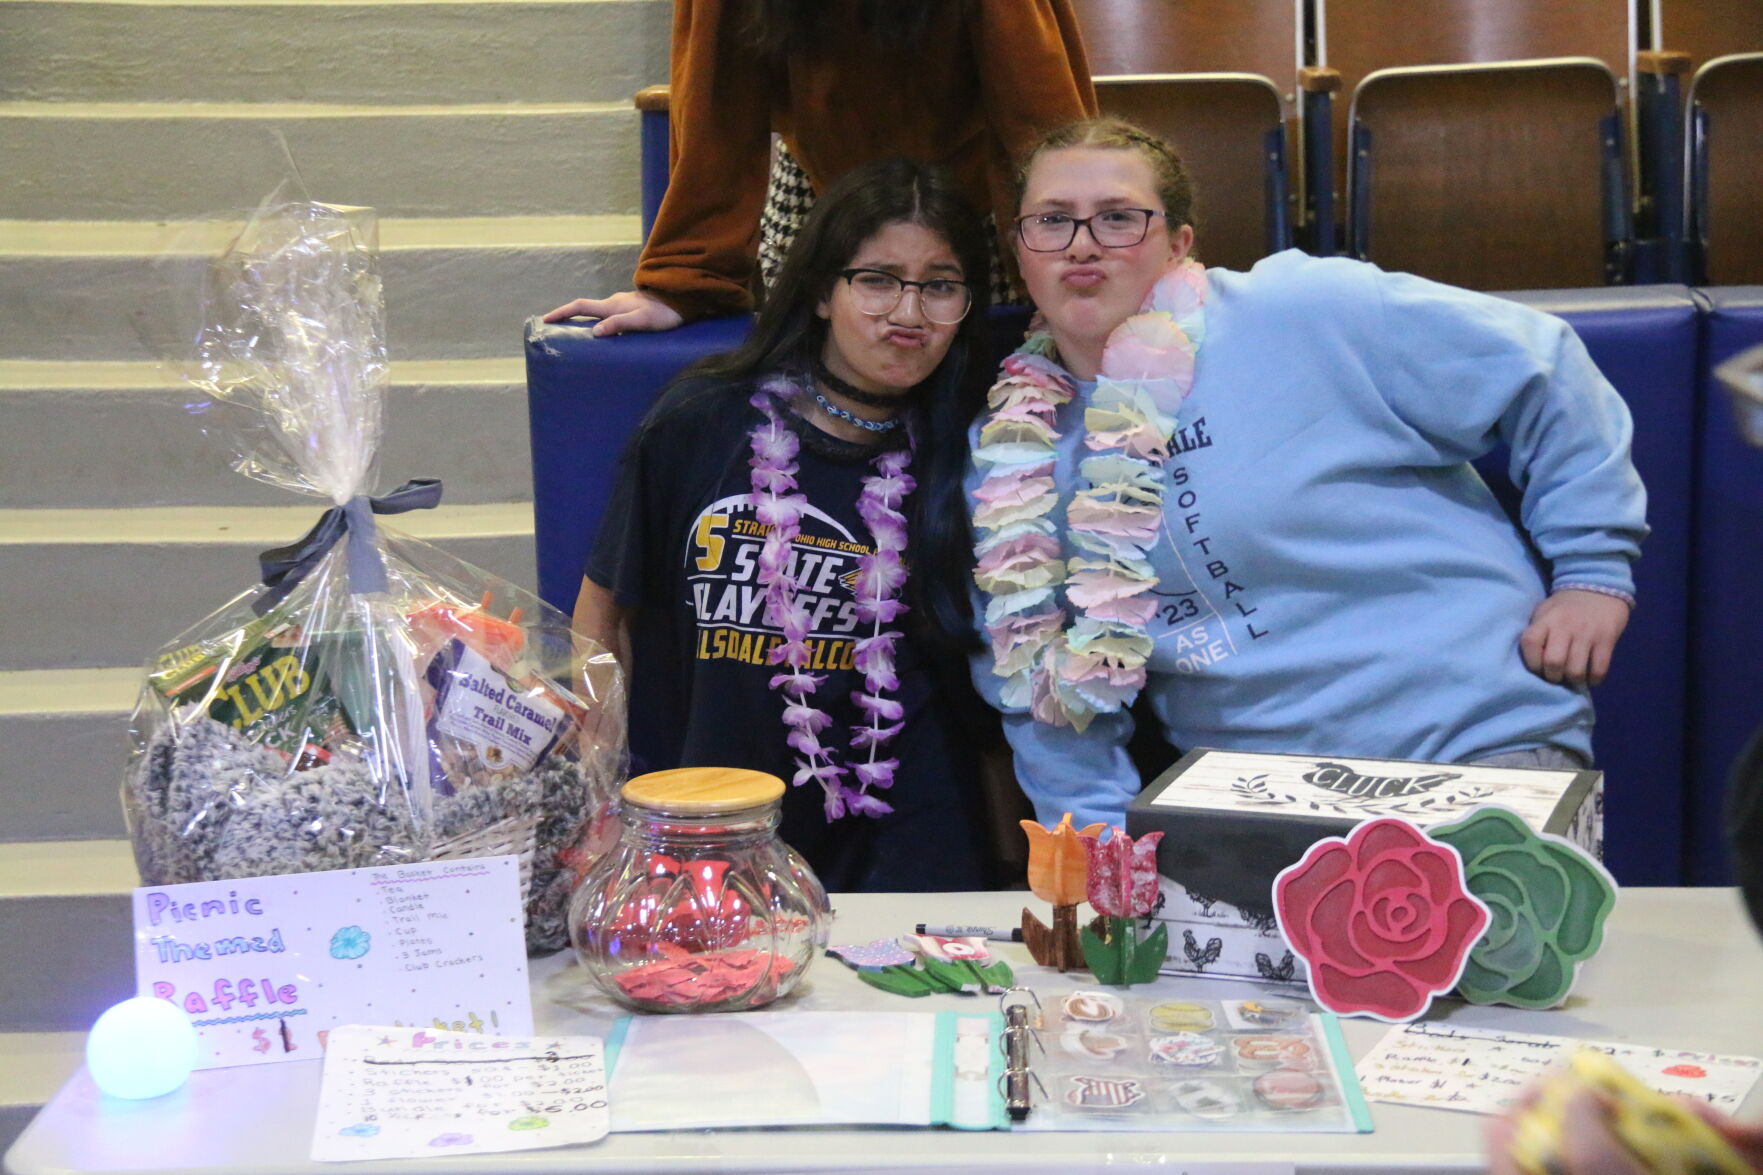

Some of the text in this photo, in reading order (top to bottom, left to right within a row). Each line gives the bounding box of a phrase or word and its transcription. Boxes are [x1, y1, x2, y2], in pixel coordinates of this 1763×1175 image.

[1166, 416, 1213, 458] ALE
[795, 534, 815, 545] OHIO
[816, 537, 837, 549] HIGH
[838, 541, 870, 555] SCHOOL
[1173, 467, 1269, 640] SOFTBALL
[731, 543, 843, 594] SATE
[1175, 640, 1229, 674] ONE
[1176, 626, 1208, 653] AS
[457, 672, 506, 705] Salted
[505, 695, 557, 733] Caramel
[473, 706, 506, 731] Trail
[506, 723, 532, 745] Mix
[1312, 767, 1447, 797] CLUCK
[146, 890, 264, 926] Picnic
[151, 927, 286, 964] Themed
[152, 978, 298, 1014] Raffle
[412, 1032, 531, 1049] Prices
